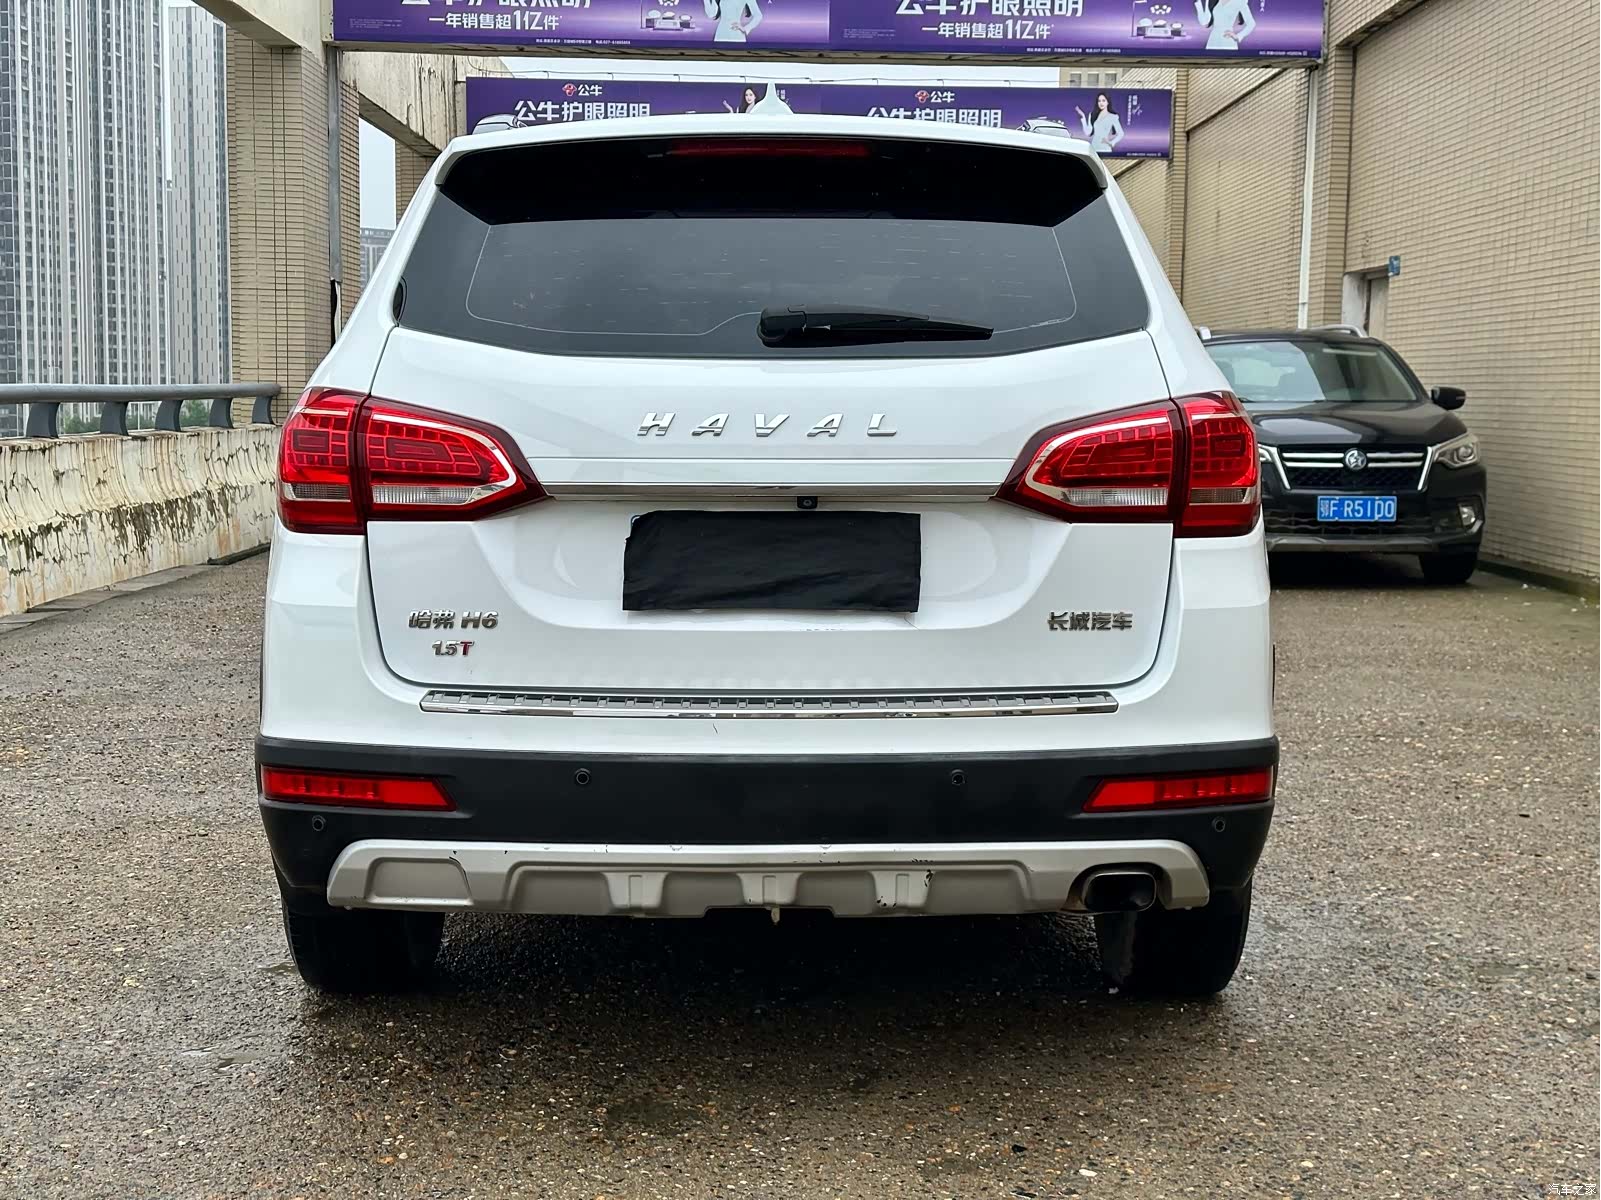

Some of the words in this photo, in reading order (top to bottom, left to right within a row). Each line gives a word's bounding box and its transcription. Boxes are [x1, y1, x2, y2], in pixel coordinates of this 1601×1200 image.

[577, 84, 603, 97] 公牛
[930, 90, 955, 103] 公牛
[513, 100, 650, 121] 公牛护眼照明
[637, 412, 898, 438] HAVAL
[408, 609, 455, 630] 哈弗
[460, 610, 499, 630] H6
[1047, 611, 1133, 631] 长城汽车
[431, 639, 475, 656] 1.5T
